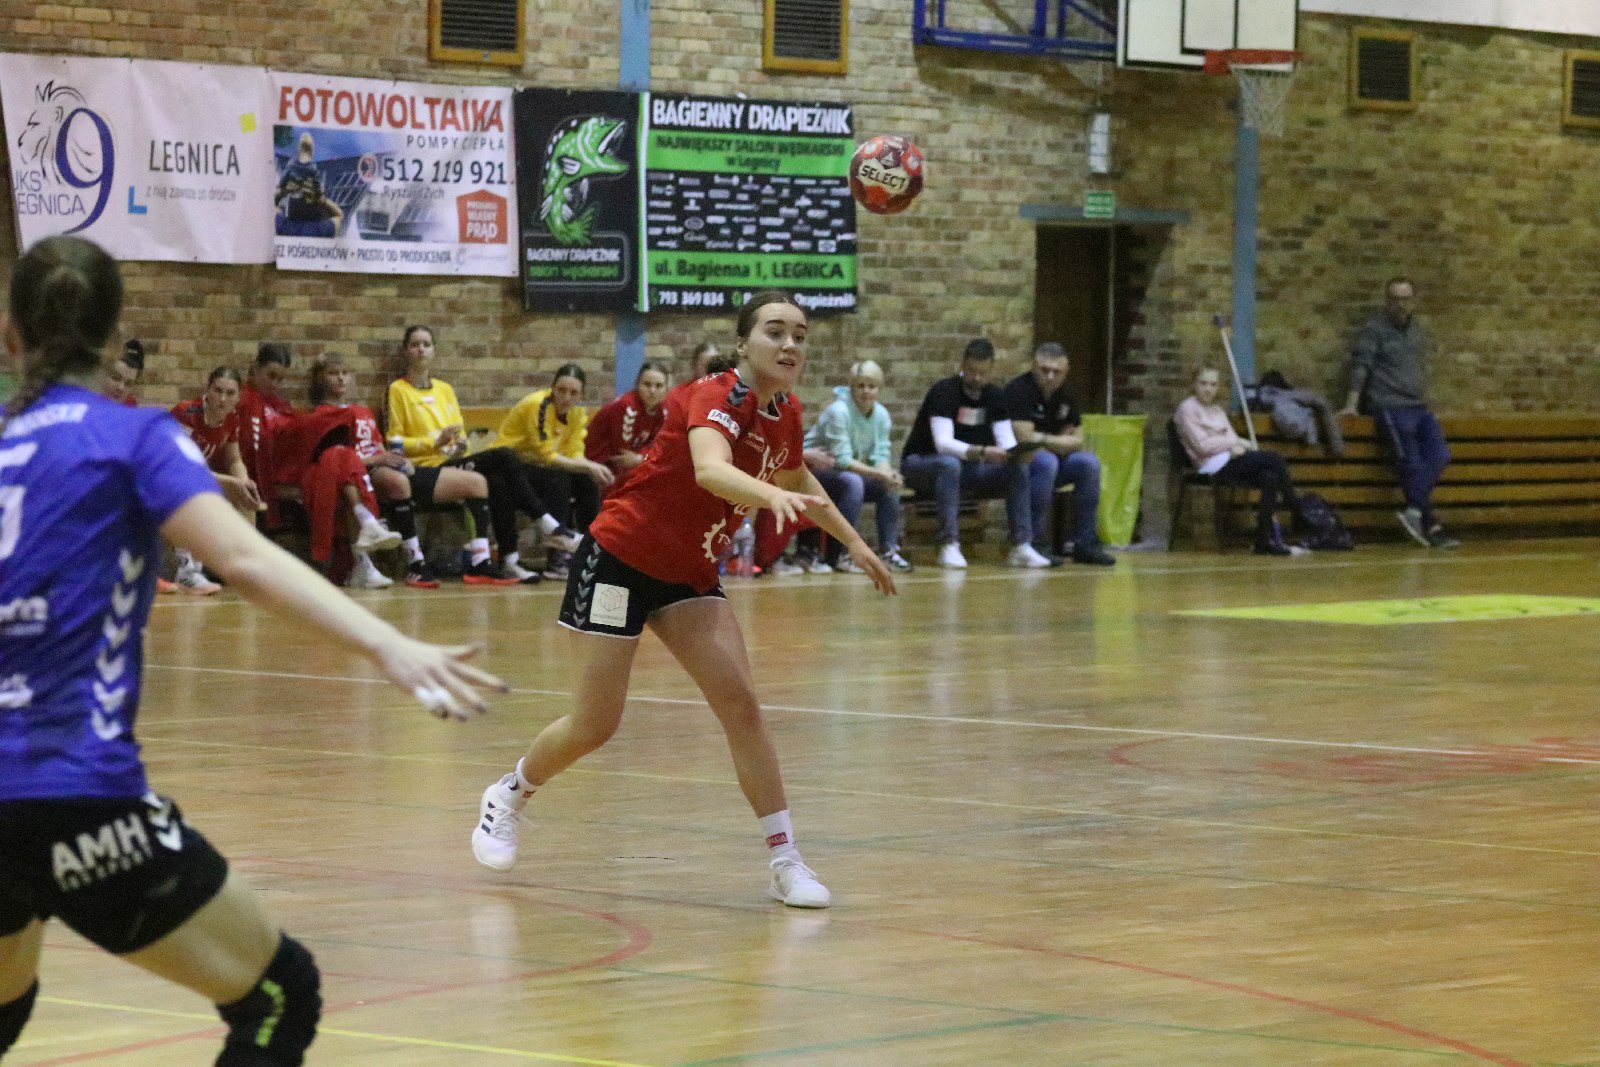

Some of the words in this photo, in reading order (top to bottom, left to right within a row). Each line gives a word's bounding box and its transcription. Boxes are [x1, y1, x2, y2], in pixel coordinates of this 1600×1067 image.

[278, 85, 505, 132] FOTOWOLTAIKA
[652, 99, 745, 129] BAGIENNY
[749, 103, 851, 134] DRAPIEŻNIK
[407, 135, 460, 149] POMPY
[149, 140, 240, 176] LEGNICA
[383, 158, 424, 182] 512
[431, 160, 463, 183] 119
[470, 160, 507, 185] 921
[861, 165, 906, 189] SELECT
[676, 258, 750, 281] Bagienna
[772, 262, 845, 279] LEGNICA
[52, 813, 153, 878] AMH
